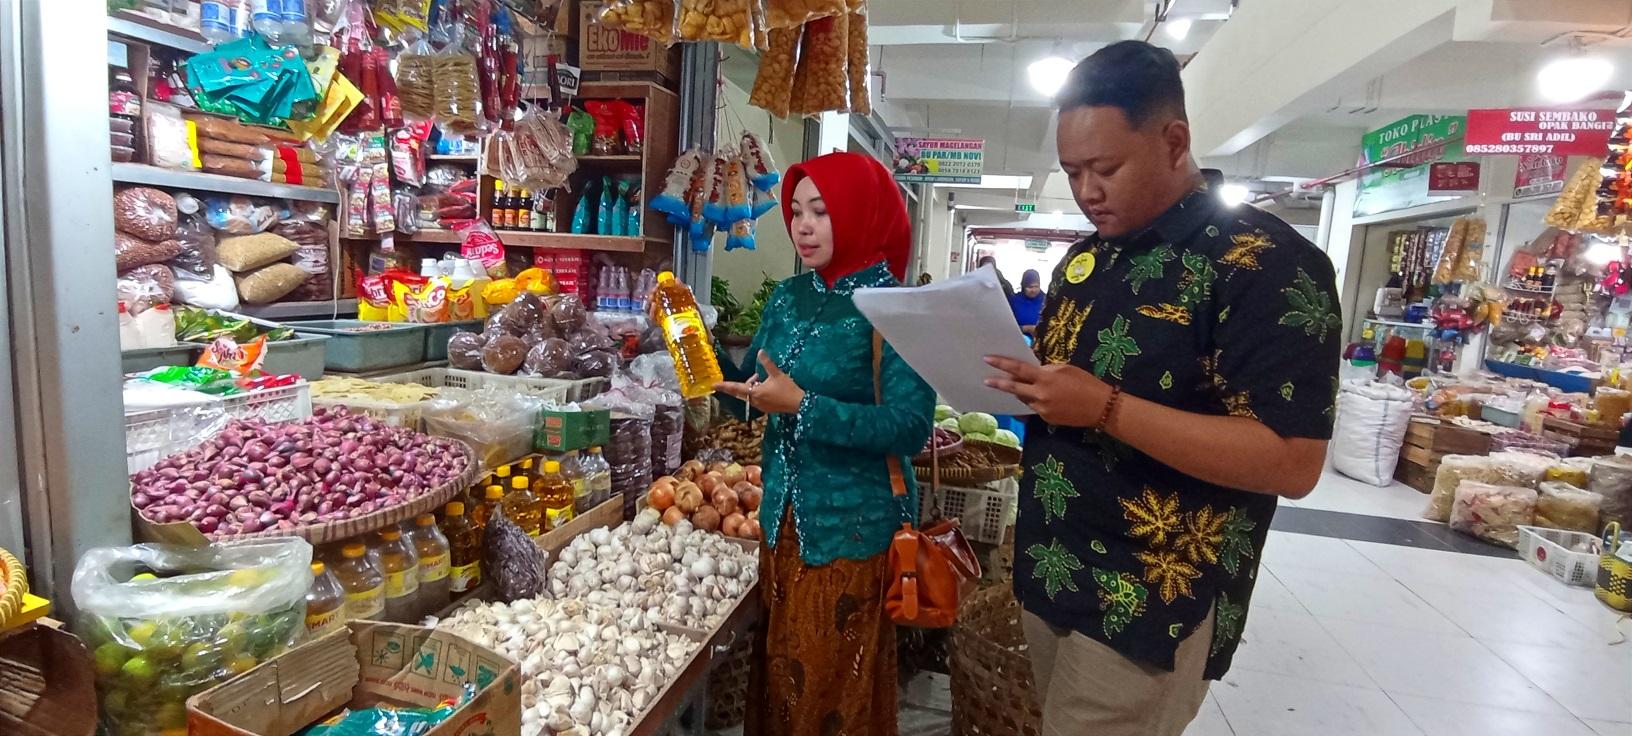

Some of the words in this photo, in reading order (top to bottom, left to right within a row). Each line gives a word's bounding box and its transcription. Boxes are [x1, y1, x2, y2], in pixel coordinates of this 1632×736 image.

[1509, 111, 1536, 122] SUSI
[1538, 111, 1598, 122] SEMBAKO
[1538, 121, 1569, 130] OPAK
[1379, 124, 1408, 145] TOKO
[1501, 132, 1522, 142] (BU
[1523, 132, 1544, 142] SRI
[1545, 132, 1576, 142] ADIL)
[1465, 144, 1554, 154] 085280357897
[963, 152, 982, 160] NOVI
